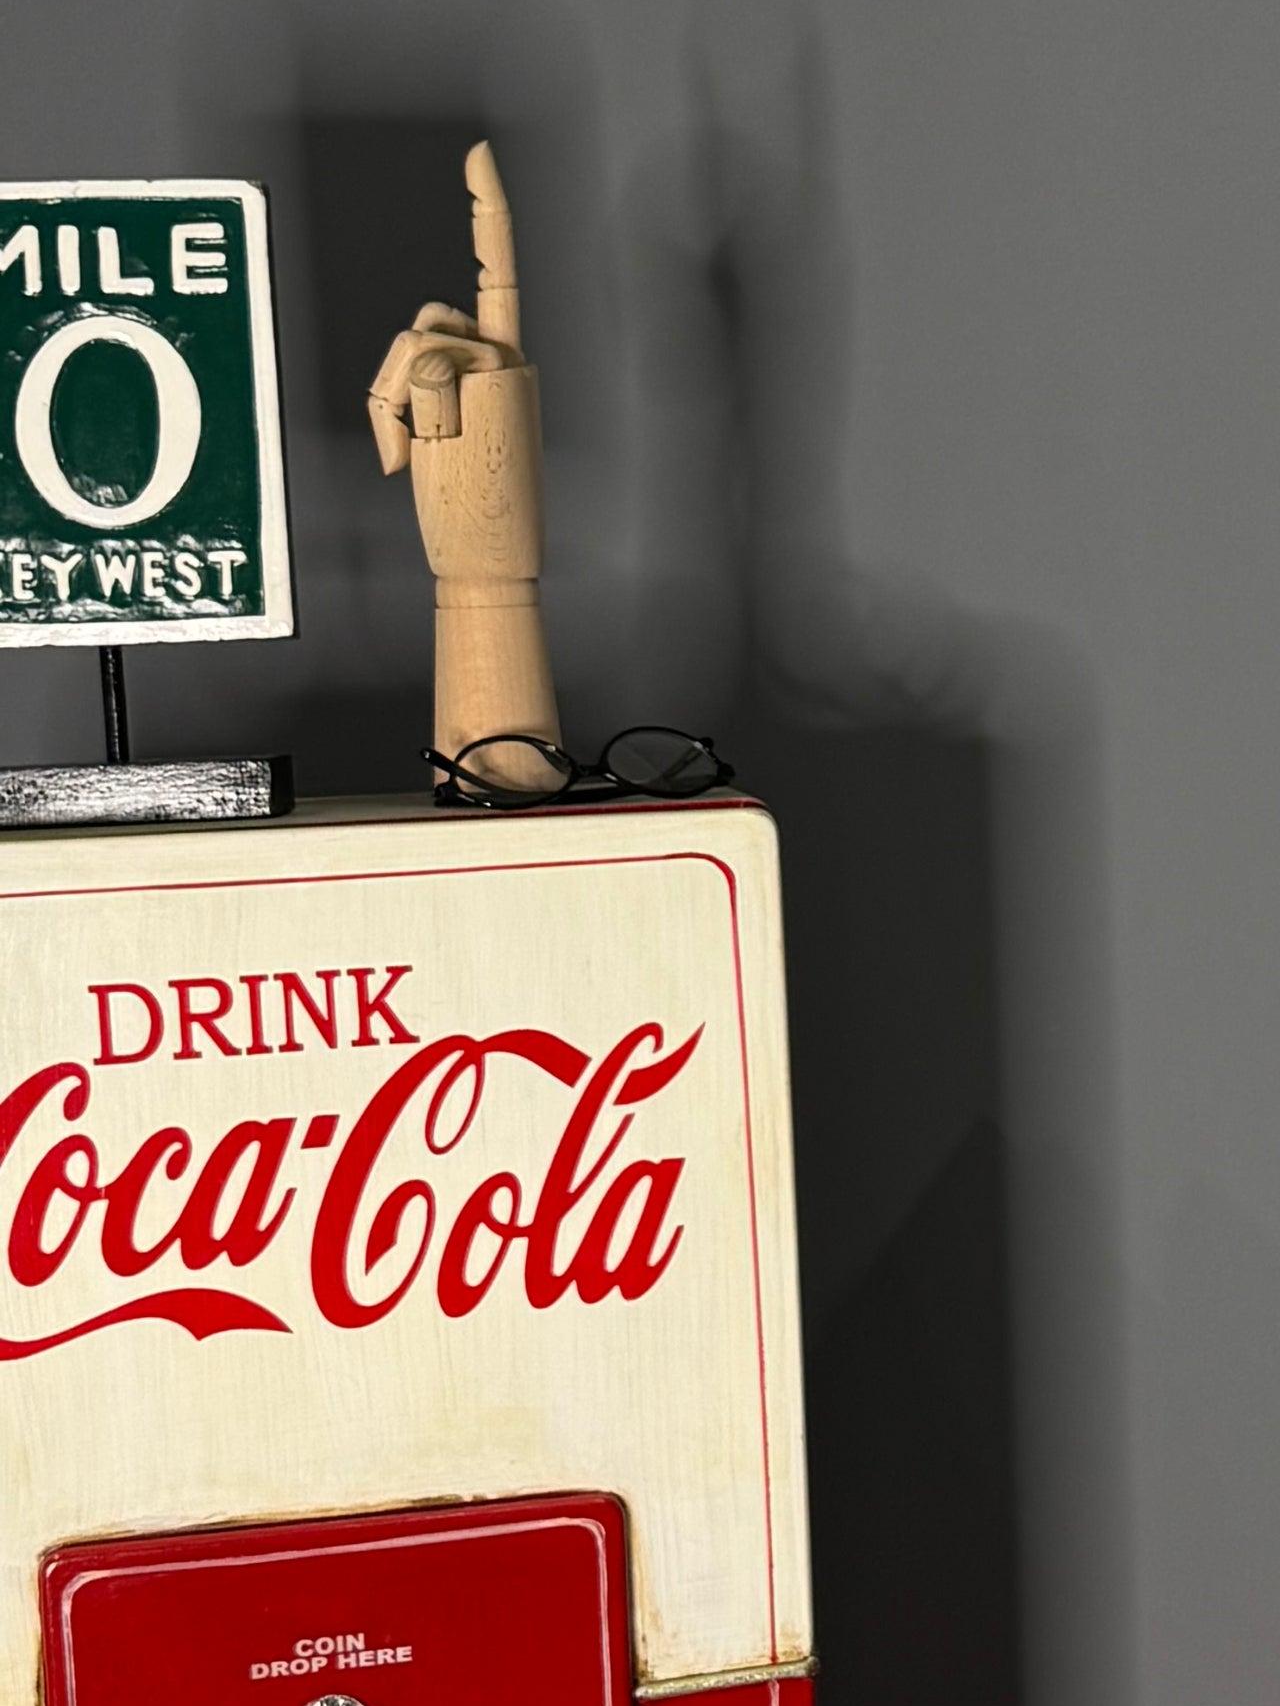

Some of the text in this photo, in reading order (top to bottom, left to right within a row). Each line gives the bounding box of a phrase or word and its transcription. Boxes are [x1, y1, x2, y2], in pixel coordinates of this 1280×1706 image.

[0, 550, 247, 601] EY WEST
[87, 965, 421, 1066] DRINK
[250, 1645, 413, 1680] DROP HERE
[294, 1632, 366, 1657] COIN
